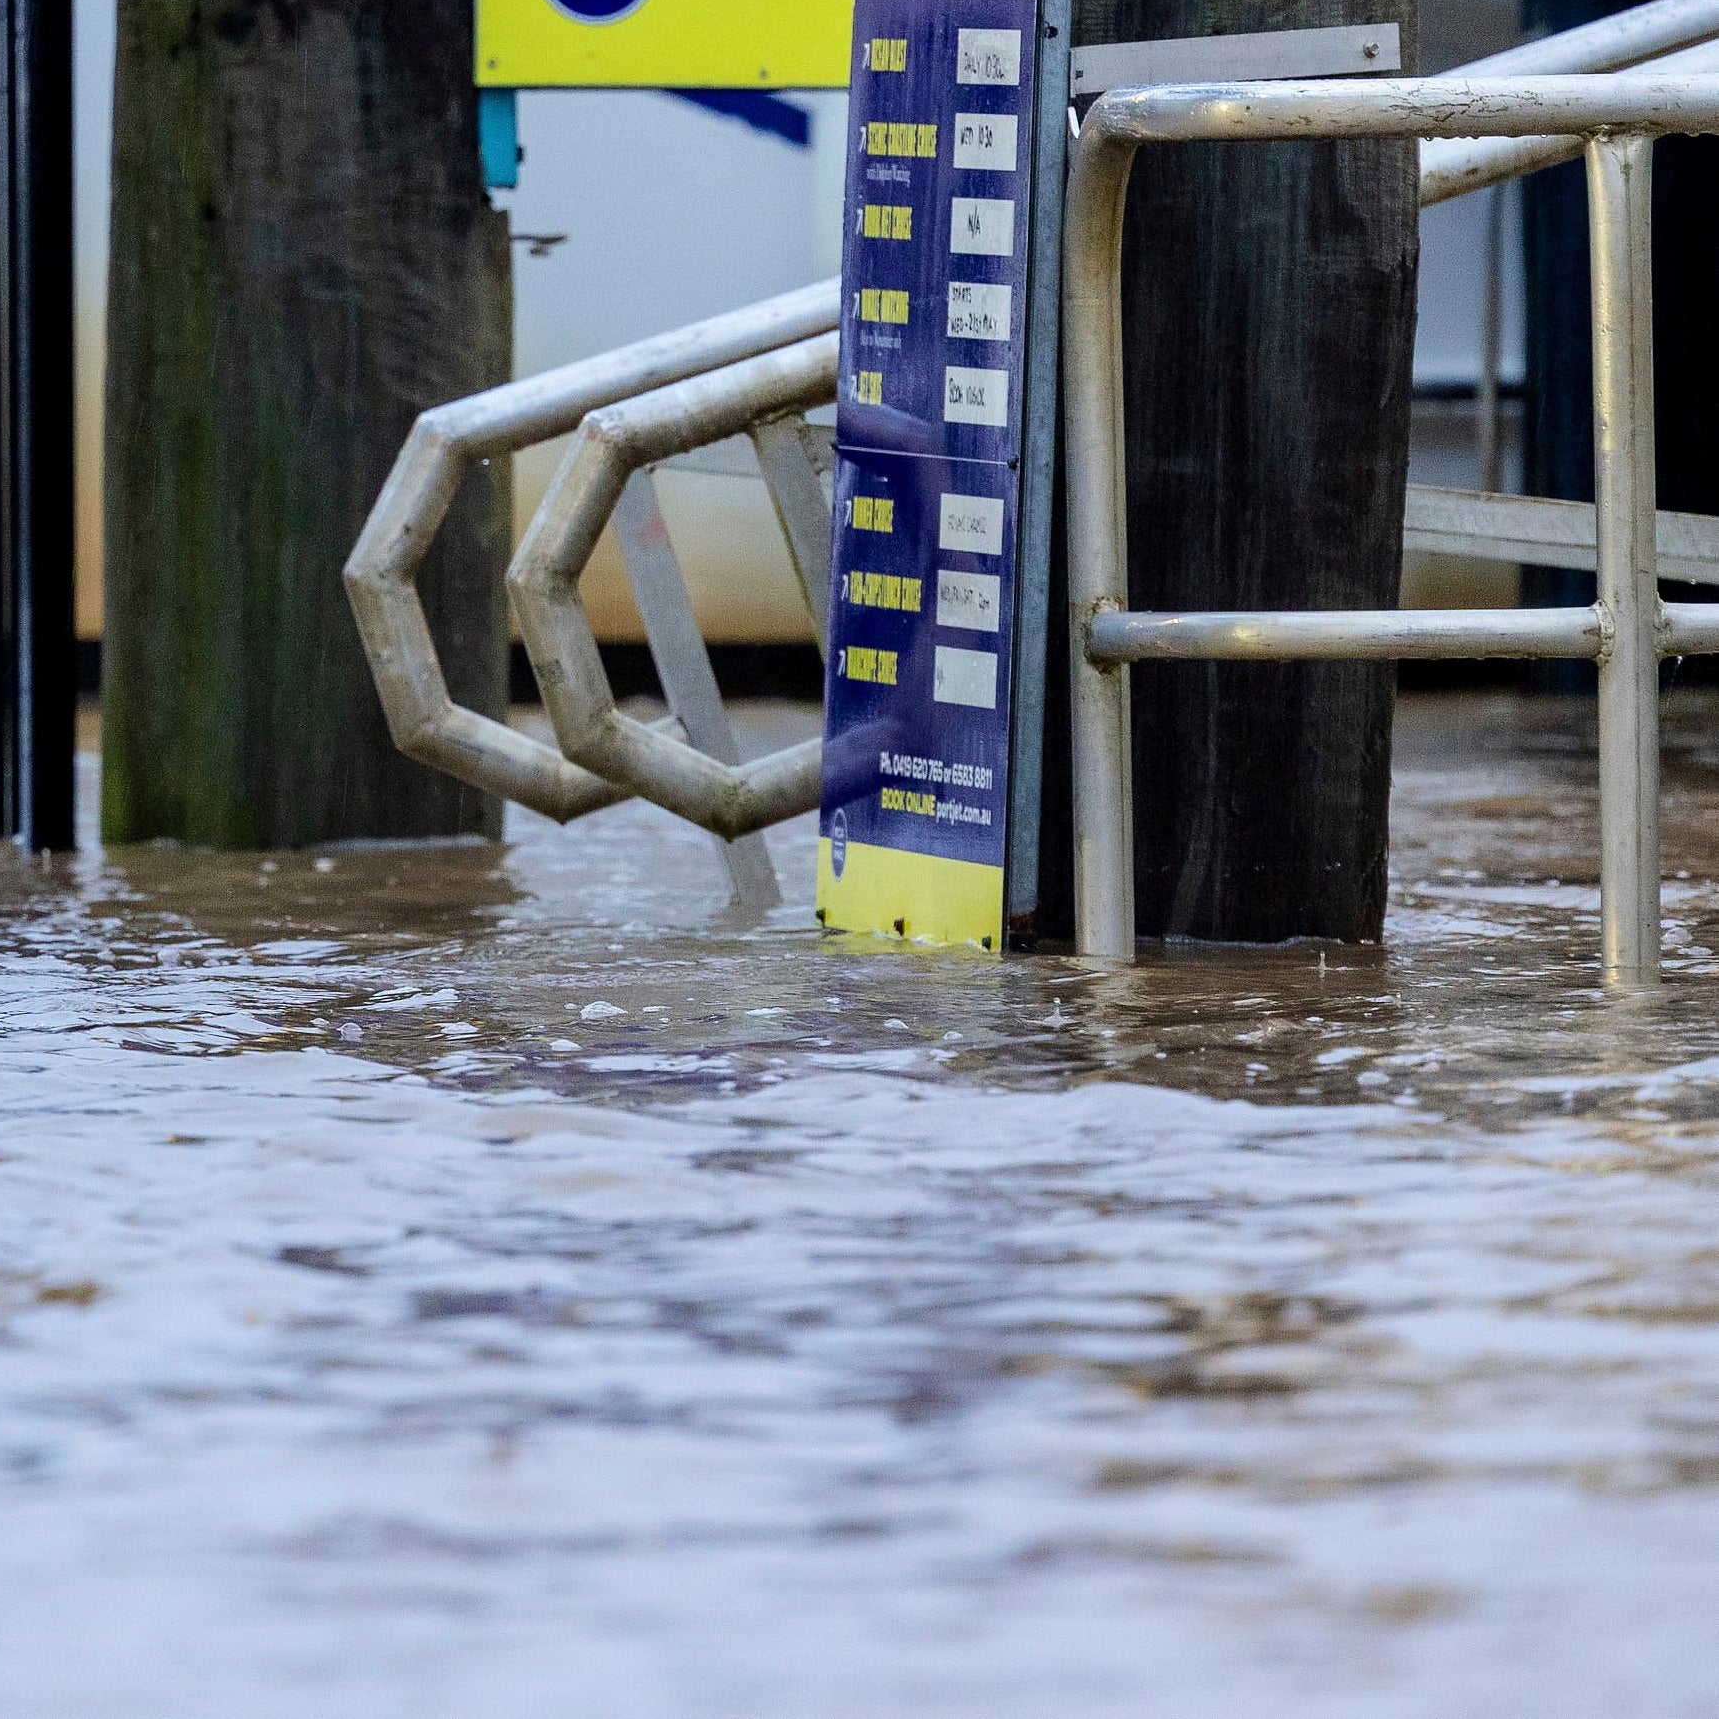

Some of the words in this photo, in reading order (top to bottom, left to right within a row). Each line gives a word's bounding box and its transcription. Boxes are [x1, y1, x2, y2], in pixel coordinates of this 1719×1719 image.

[968, 204, 981, 238] N/A
[879, 751, 892, 775] Ph.
[893, 755, 912, 778] 0419
[913, 757, 928, 780] 620
[943, 767, 951, 783] or
[975, 766, 993, 790] 8811
[881, 787, 905, 812] BOOK
[906, 790, 936, 817] ONLINE
[936, 798, 992, 826] portjet.com.au
